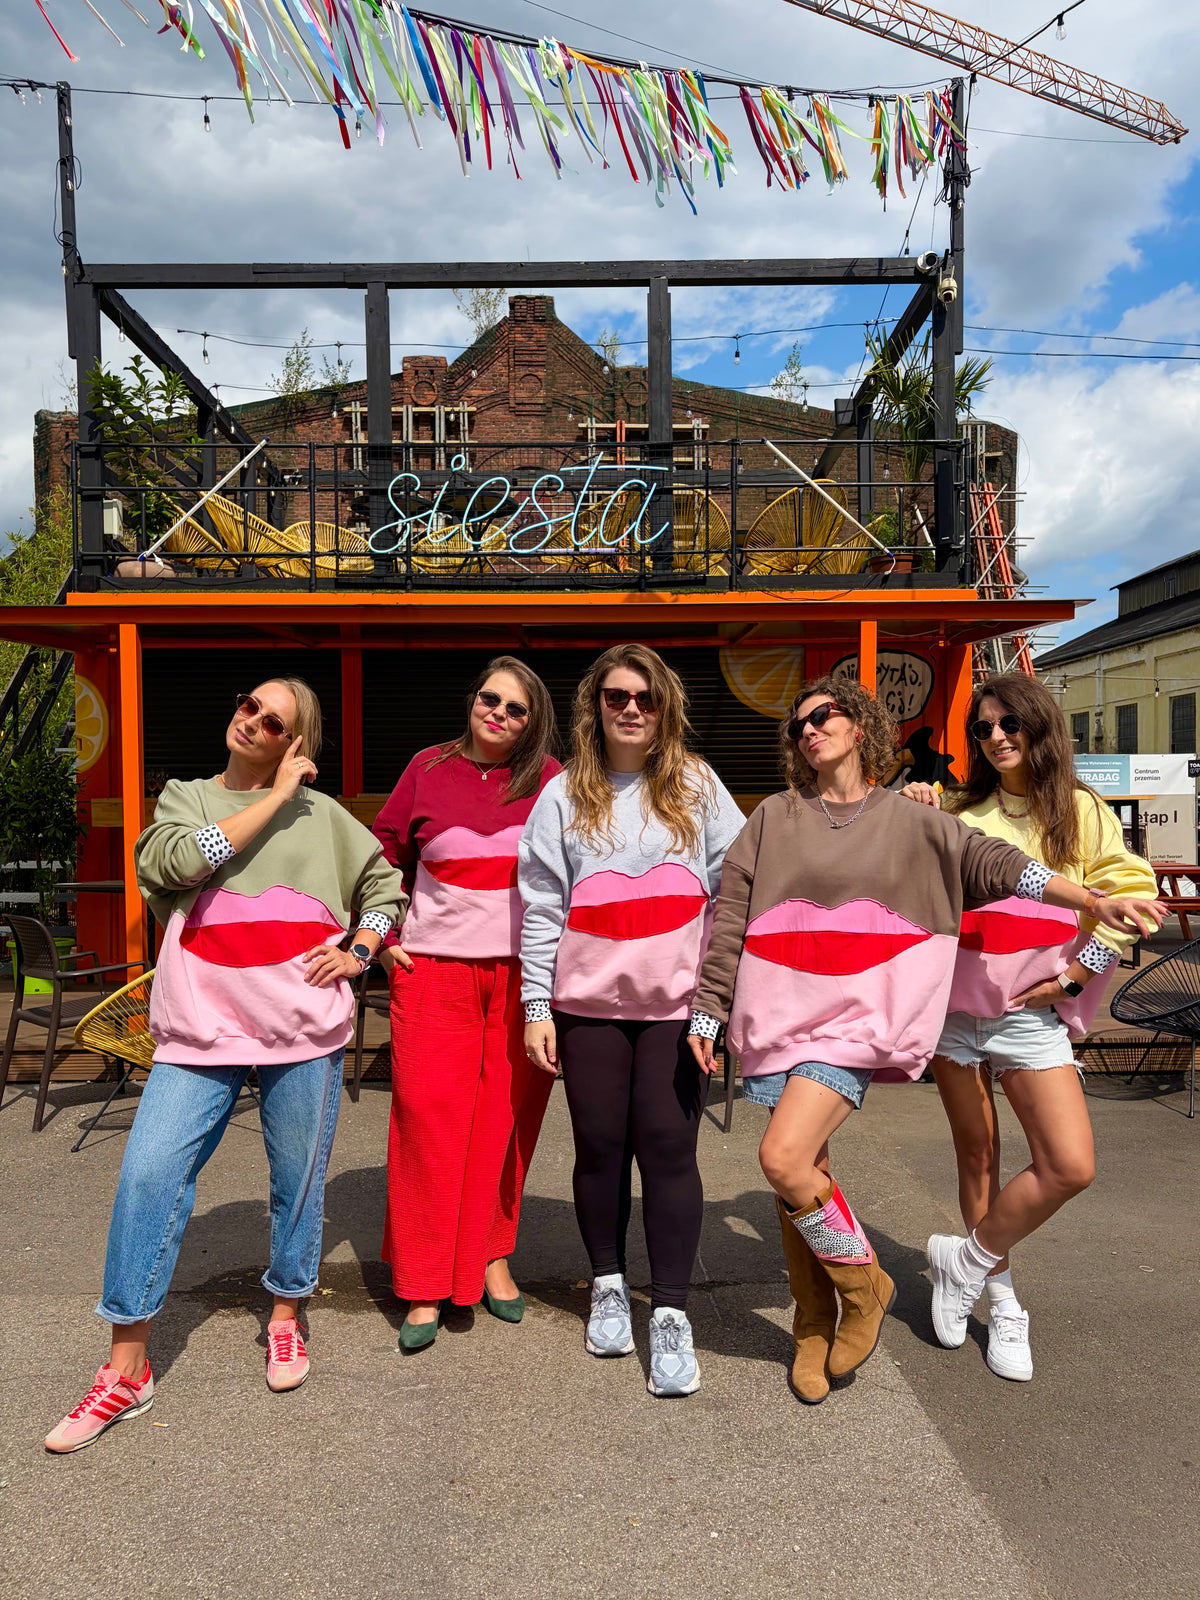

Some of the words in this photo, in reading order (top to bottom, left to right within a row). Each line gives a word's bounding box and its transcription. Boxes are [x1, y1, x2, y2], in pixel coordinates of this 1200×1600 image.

[368, 451, 670, 554] siesta
[1138, 811, 1169, 826] etap
[1173, 810, 1178, 823] I
